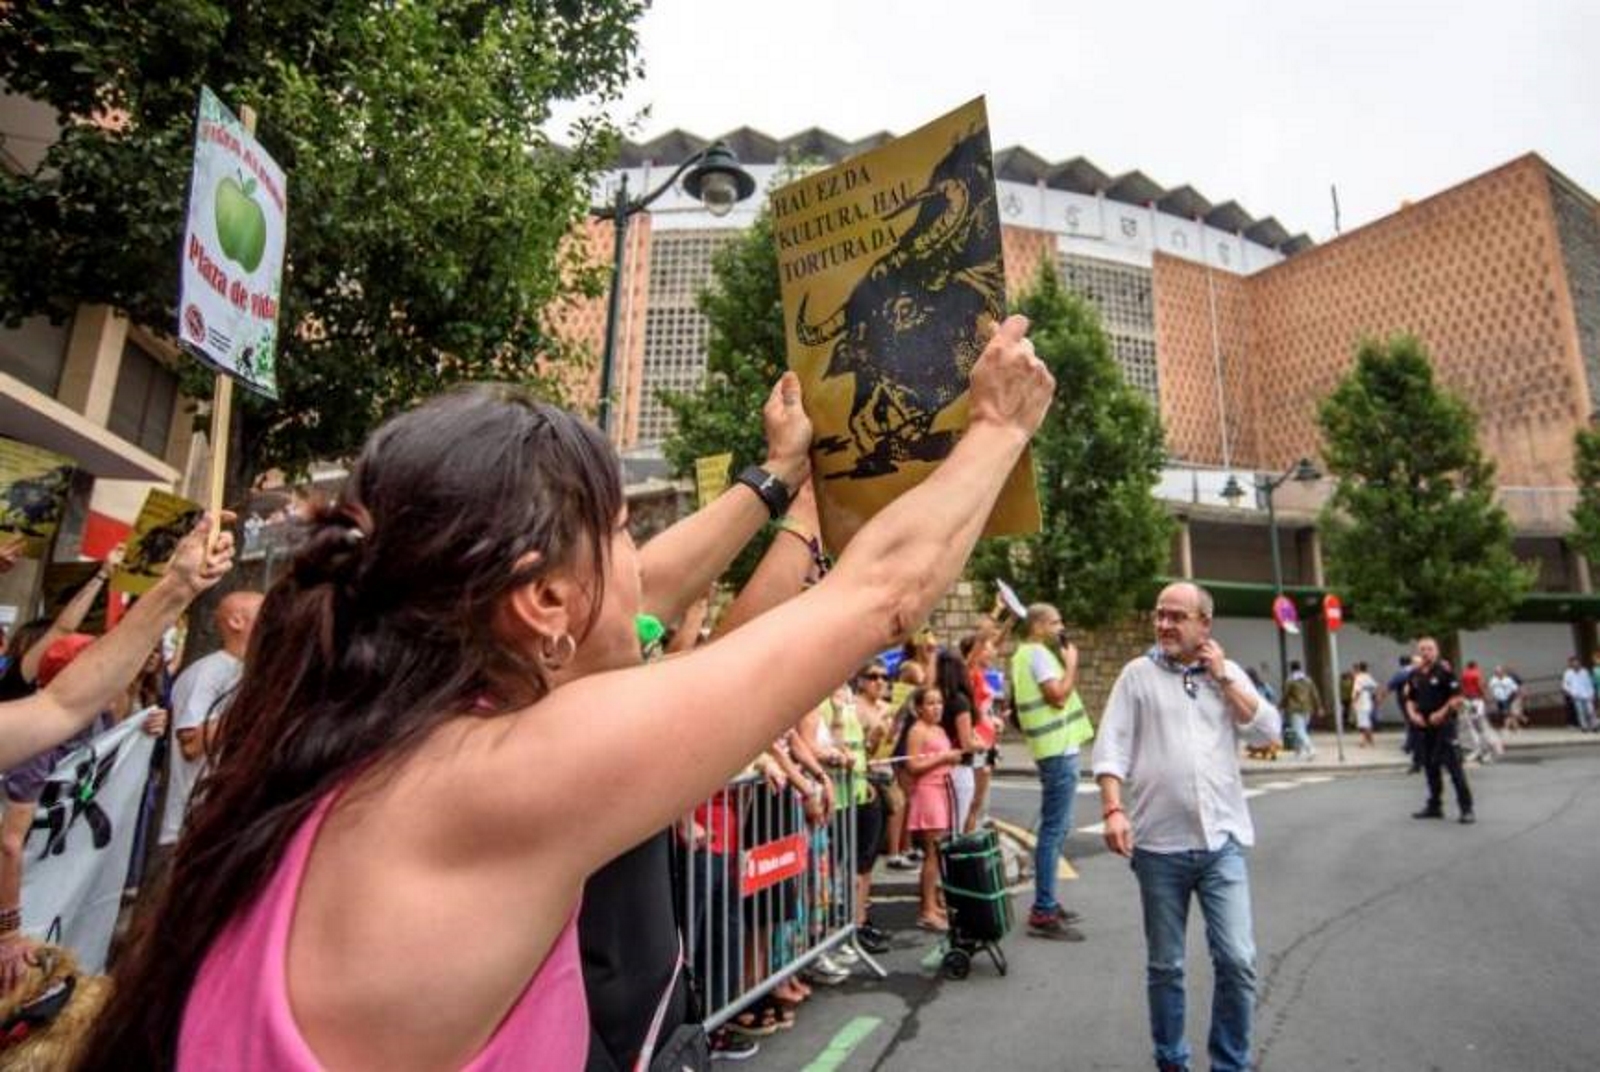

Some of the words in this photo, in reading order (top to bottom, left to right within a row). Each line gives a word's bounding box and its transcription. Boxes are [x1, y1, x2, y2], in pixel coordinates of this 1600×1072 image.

[774, 187, 811, 218] HAU
[817, 175, 841, 201] EZ
[843, 165, 872, 190] DA
[189, 233, 227, 296] Plaza
[230, 281, 249, 312] de
[781, 236, 868, 281] TORTURA
[870, 225, 898, 251] DA
